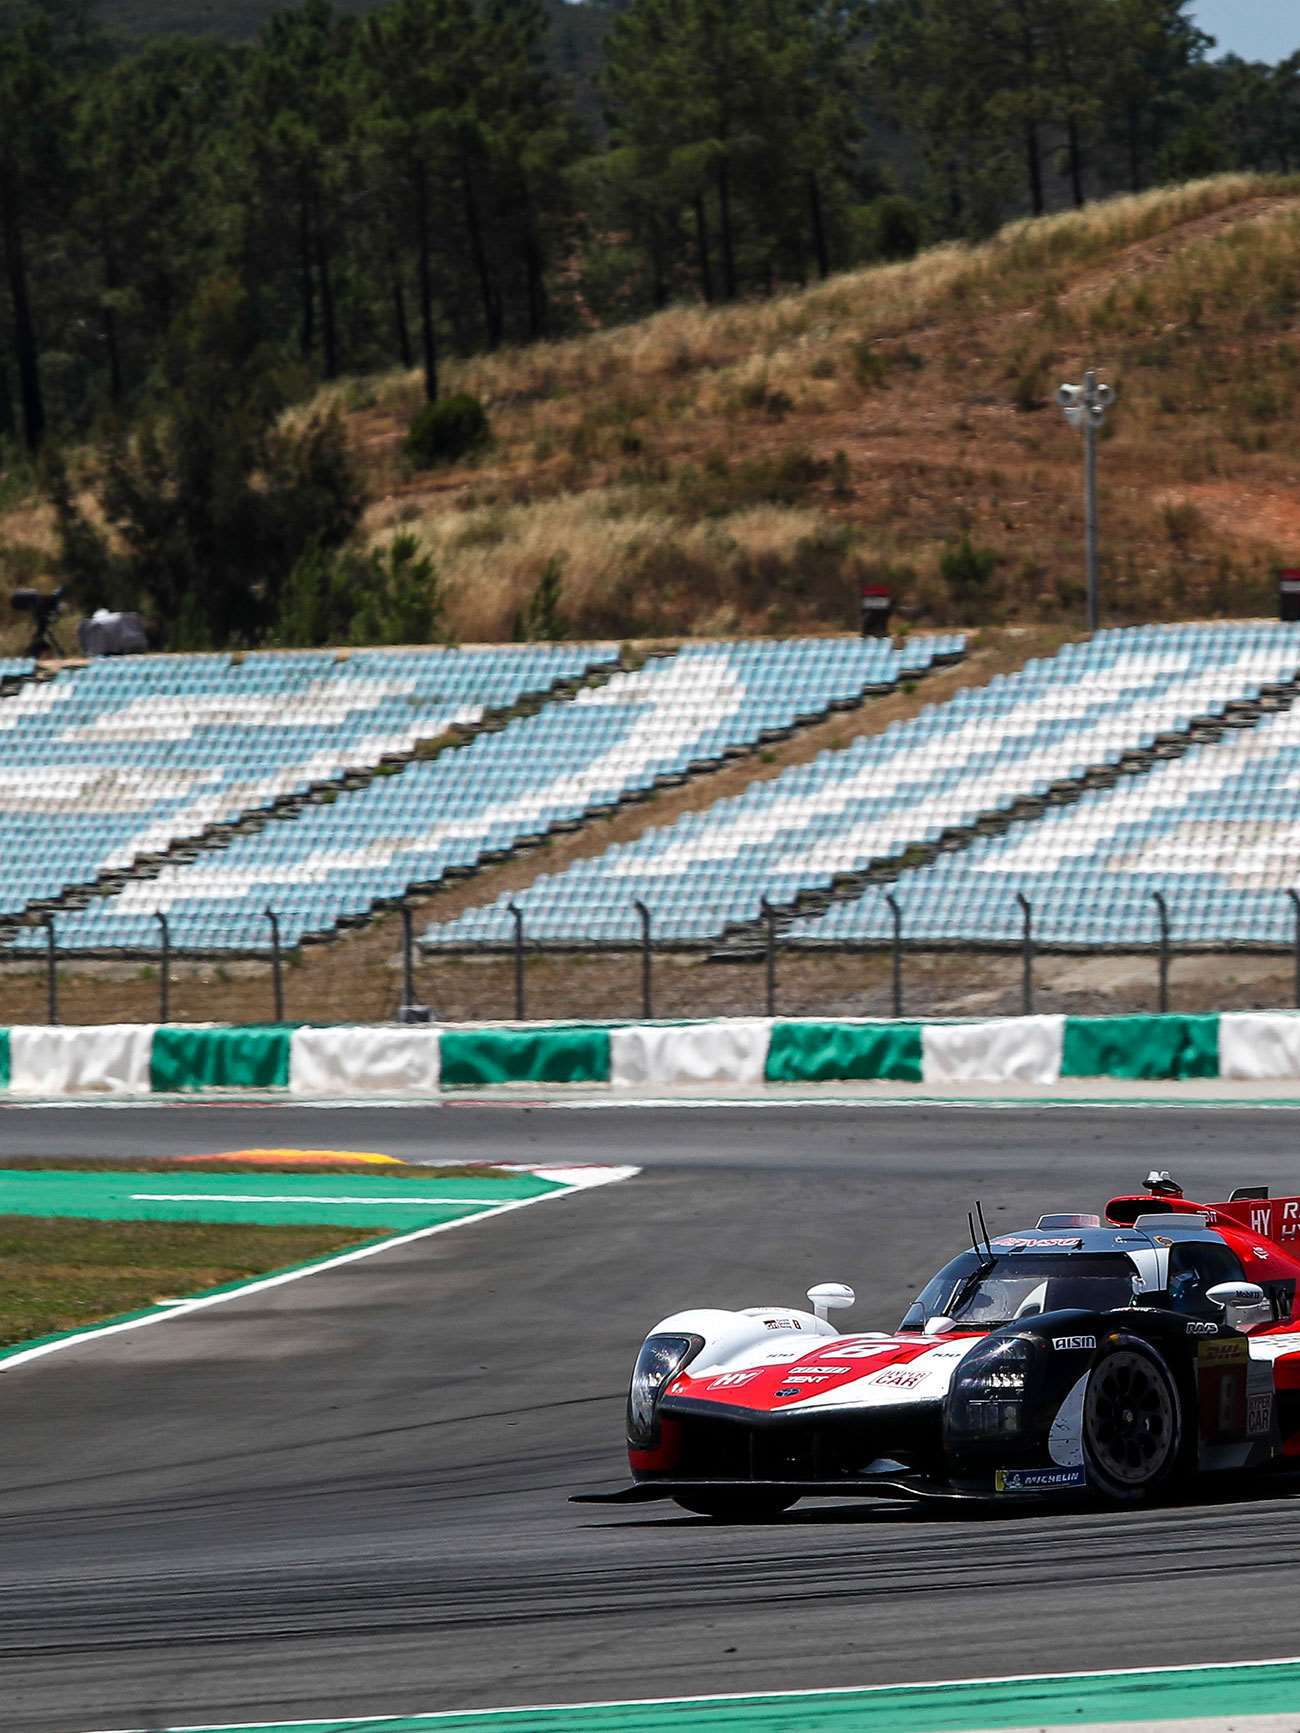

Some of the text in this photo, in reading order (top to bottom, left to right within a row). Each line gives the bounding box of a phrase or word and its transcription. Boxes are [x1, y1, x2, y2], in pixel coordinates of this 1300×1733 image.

[1250, 1208, 1271, 1236] HY
[1186, 1322, 1219, 1334] RAYS
[711, 1371, 758, 1387] HY
[781, 1375, 829, 1384] ZENT
[876, 1375, 919, 1388] CAR
[1248, 1409, 1270, 1431] CAR
[1024, 1472, 1080, 1485] MICHELIN
